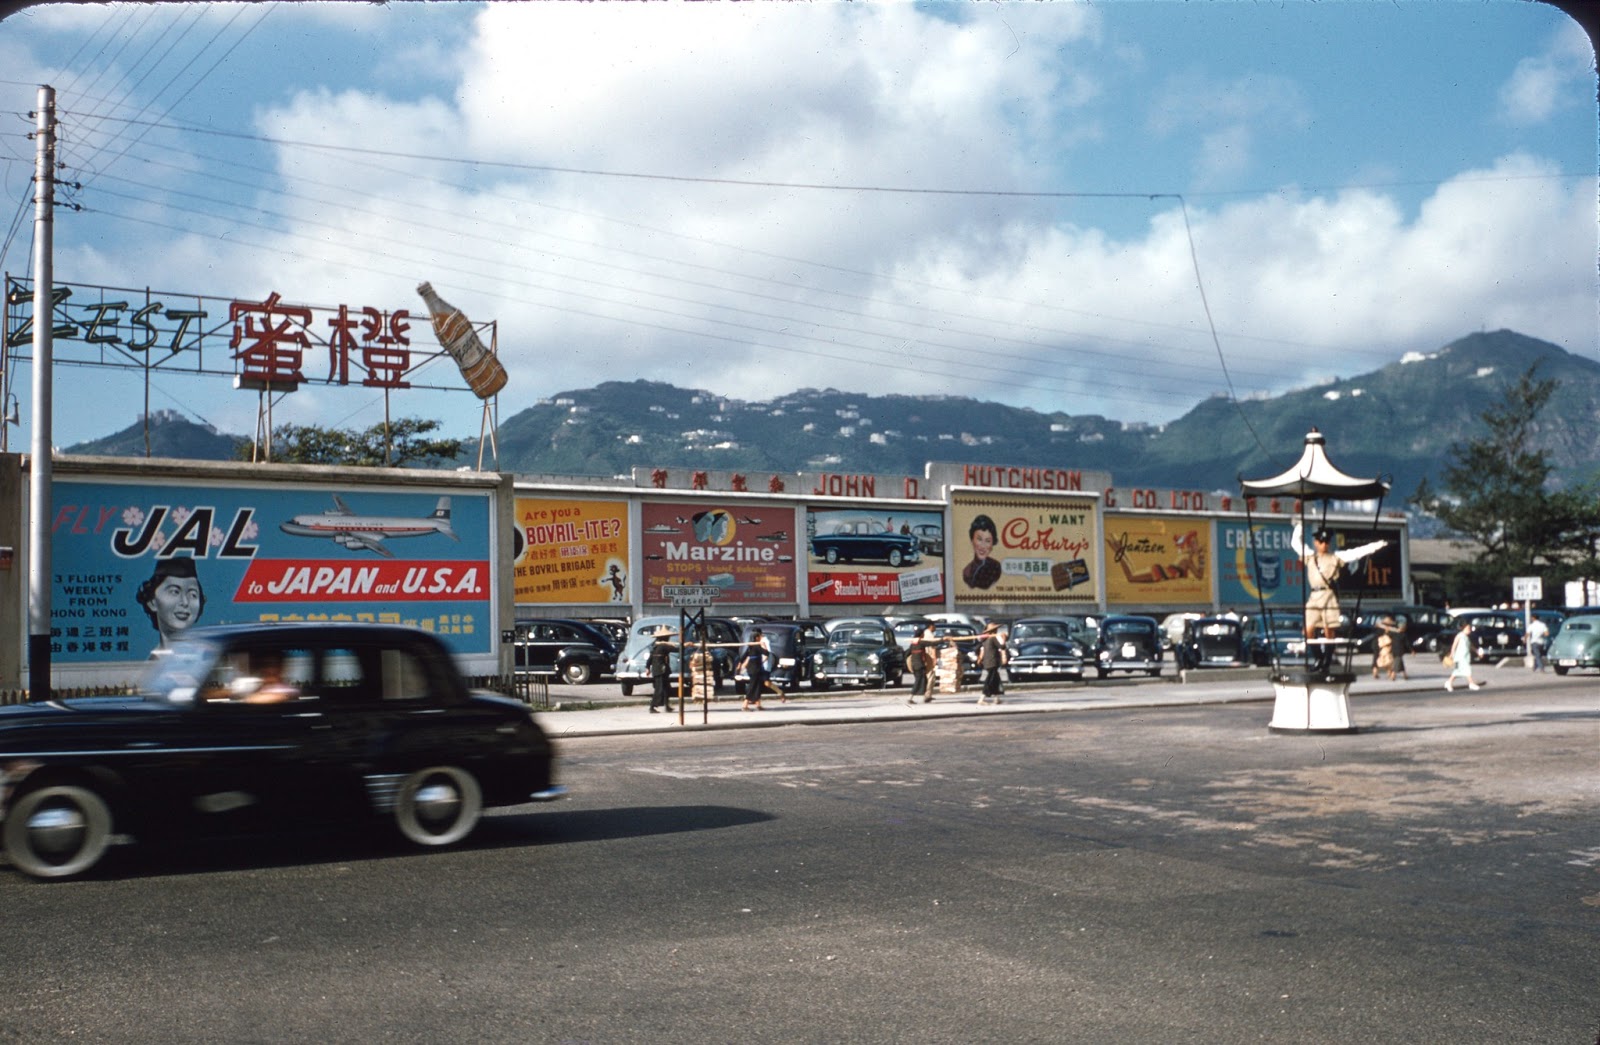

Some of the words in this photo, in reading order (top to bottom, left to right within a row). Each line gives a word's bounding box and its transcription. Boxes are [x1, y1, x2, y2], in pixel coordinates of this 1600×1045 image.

[813, 473, 875, 497] JOHN
[904, 476, 926, 499] D.
[963, 464, 1082, 491] HUTCHISON
[1171, 490, 1208, 511] LTD.
[525, 510, 547, 521] Are
[551, 507, 571, 523] you
[574, 508, 581, 516] a
[1039, 514, 1043, 524] I
[1049, 514, 1085, 525] WANT
[52, 505, 118, 534] FLY
[111, 505, 260, 559] JAL
[525, 519, 621, 546] BOVRIL-ITE?
[1001, 517, 1089, 559] Cadbury's
[1226, 529, 1292, 549] CRESCEN
[1114, 531, 1166, 563] Jantzen
[530, 563, 559, 576] BOVRIL
[561, 559, 596, 572] BRIGADE
[666, 563, 702, 573] STOPS
[55, 575, 62, 583] 3
[68, 575, 123, 583] FLIGHTS
[248, 577, 263, 594] to
[267, 567, 379, 594] JAPAN
[375, 580, 400, 594] and
[402, 567, 481, 594] U.S.A.
[63, 586, 113, 595] WEEKLY
[665, 588, 699, 596] SALISBURY
[702, 588, 719, 596] ROAD
[834, 580, 861, 596] Standard
[862, 580, 890, 599] Vanguard
[69, 597, 107, 606] FROM
[50, 609, 85, 617] HONG
[92, 608, 127, 617] KONG
